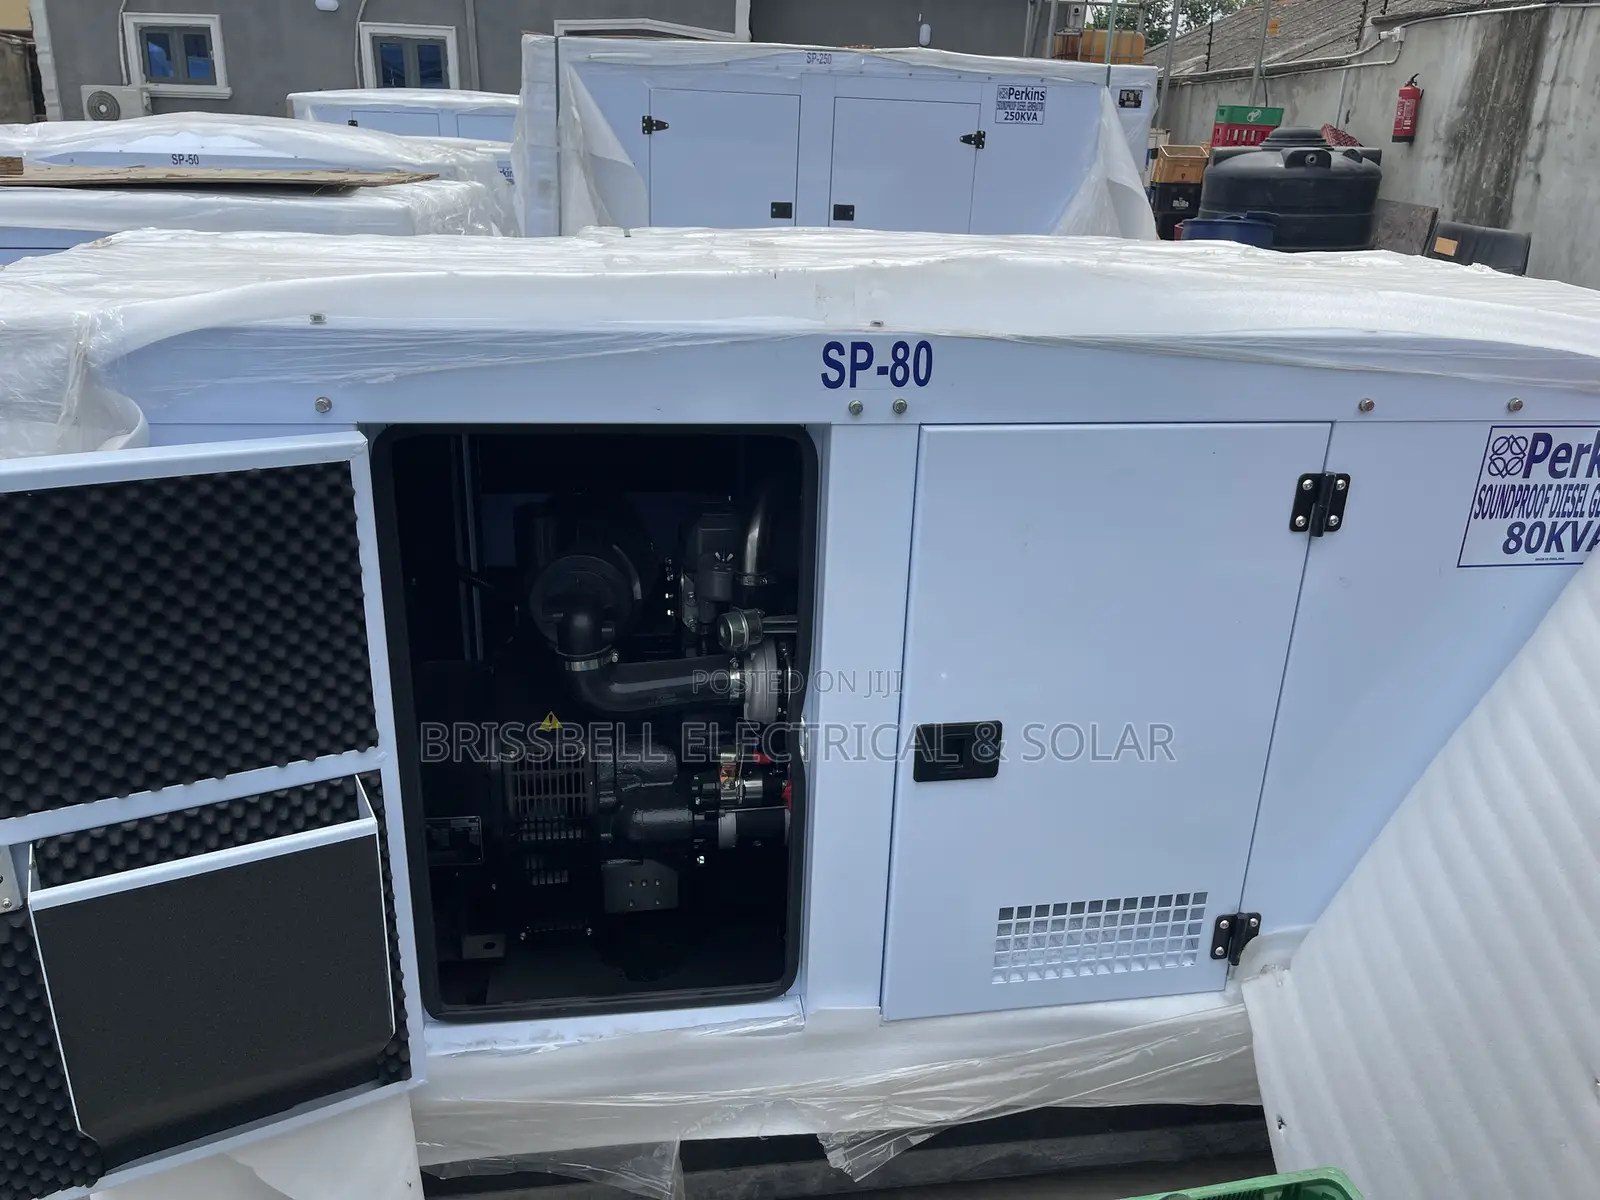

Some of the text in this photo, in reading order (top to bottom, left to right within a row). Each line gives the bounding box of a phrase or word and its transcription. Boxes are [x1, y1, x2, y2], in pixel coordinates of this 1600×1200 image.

[806, 52, 832, 65] SP-250
[1008, 87, 1045, 101] Perkins
[1004, 111, 1038, 122] 250KVA
[171, 153, 200, 166] SP-50
[821, 340, 933, 389] SP-80
[1473, 483, 1553, 520] SOUNDPROOF
[1548, 483, 1589, 519] DIESEL
